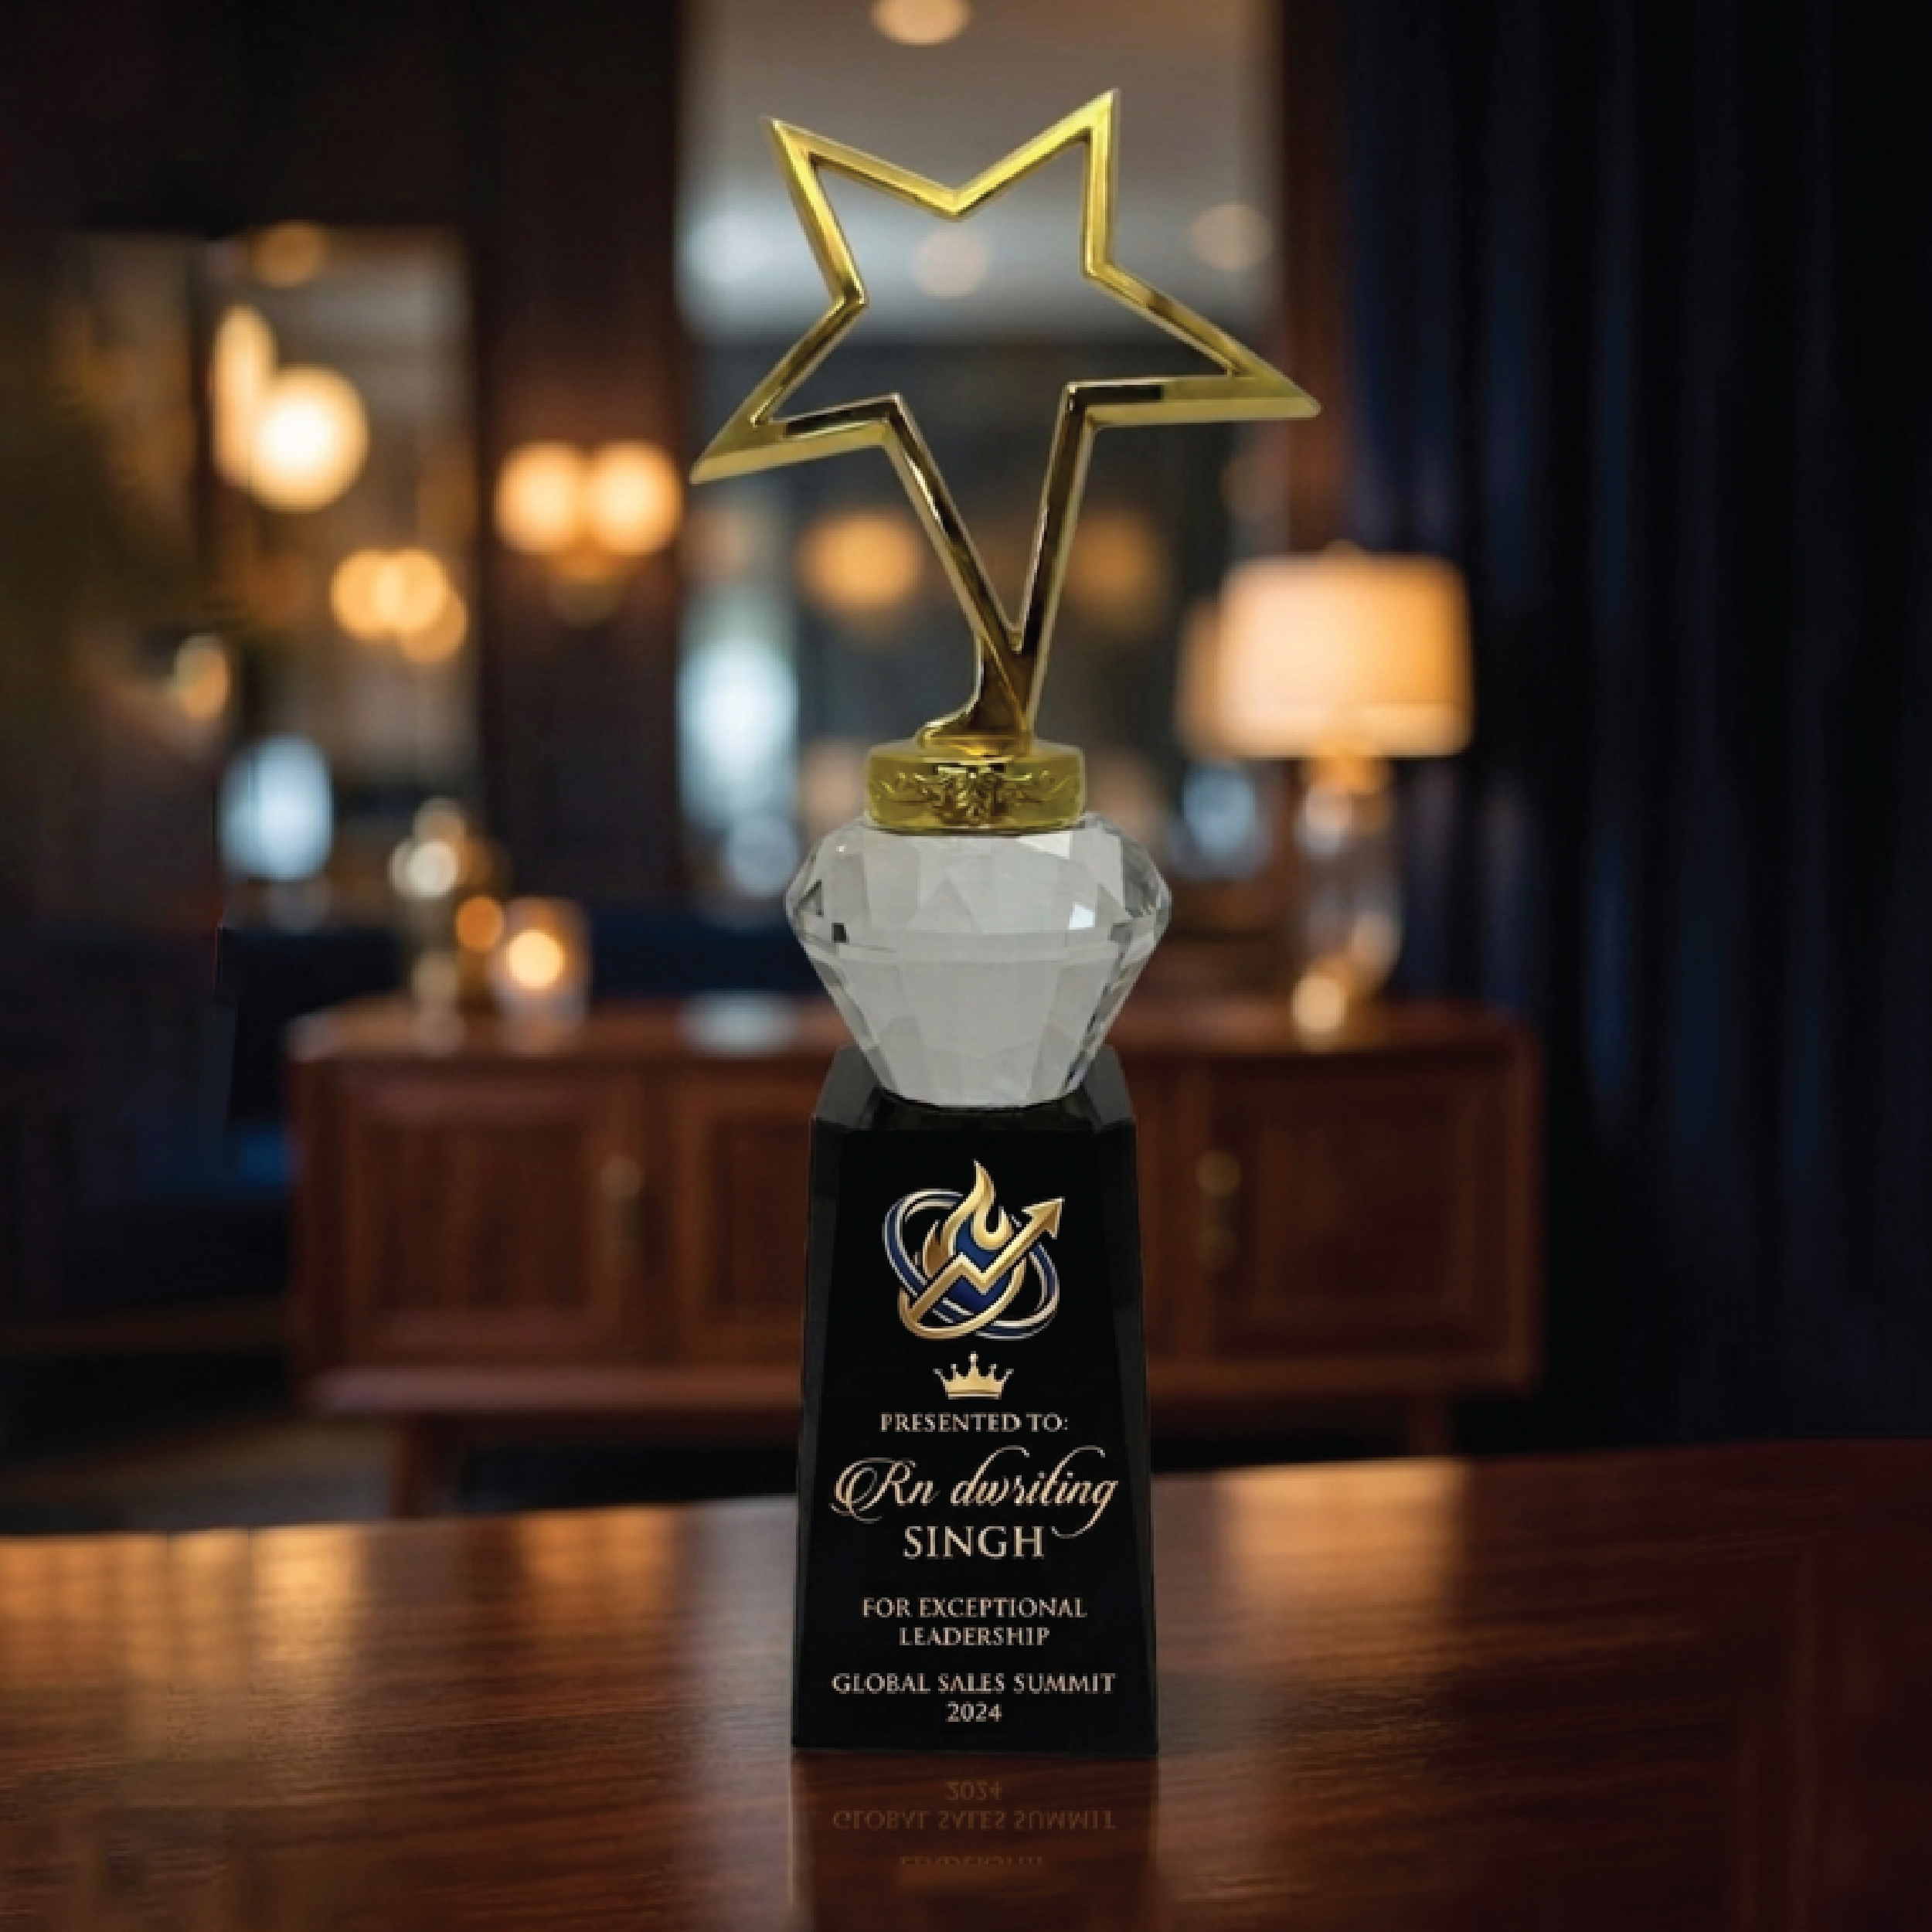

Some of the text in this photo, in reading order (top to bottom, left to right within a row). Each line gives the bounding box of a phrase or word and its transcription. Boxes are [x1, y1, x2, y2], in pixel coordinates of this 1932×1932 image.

[879, 1413, 1069, 1433] PRESENTED TO:
[903, 1525, 1045, 1560] SINGH
[862, 1597, 1087, 1618] FOR EXCEPTIONAL
[899, 1626, 1050, 1647] LEADERSHIP
[831, 1672, 1117, 1695] GLOBAL SALES SUMMIT
[944, 1700, 1003, 1723] 2024
